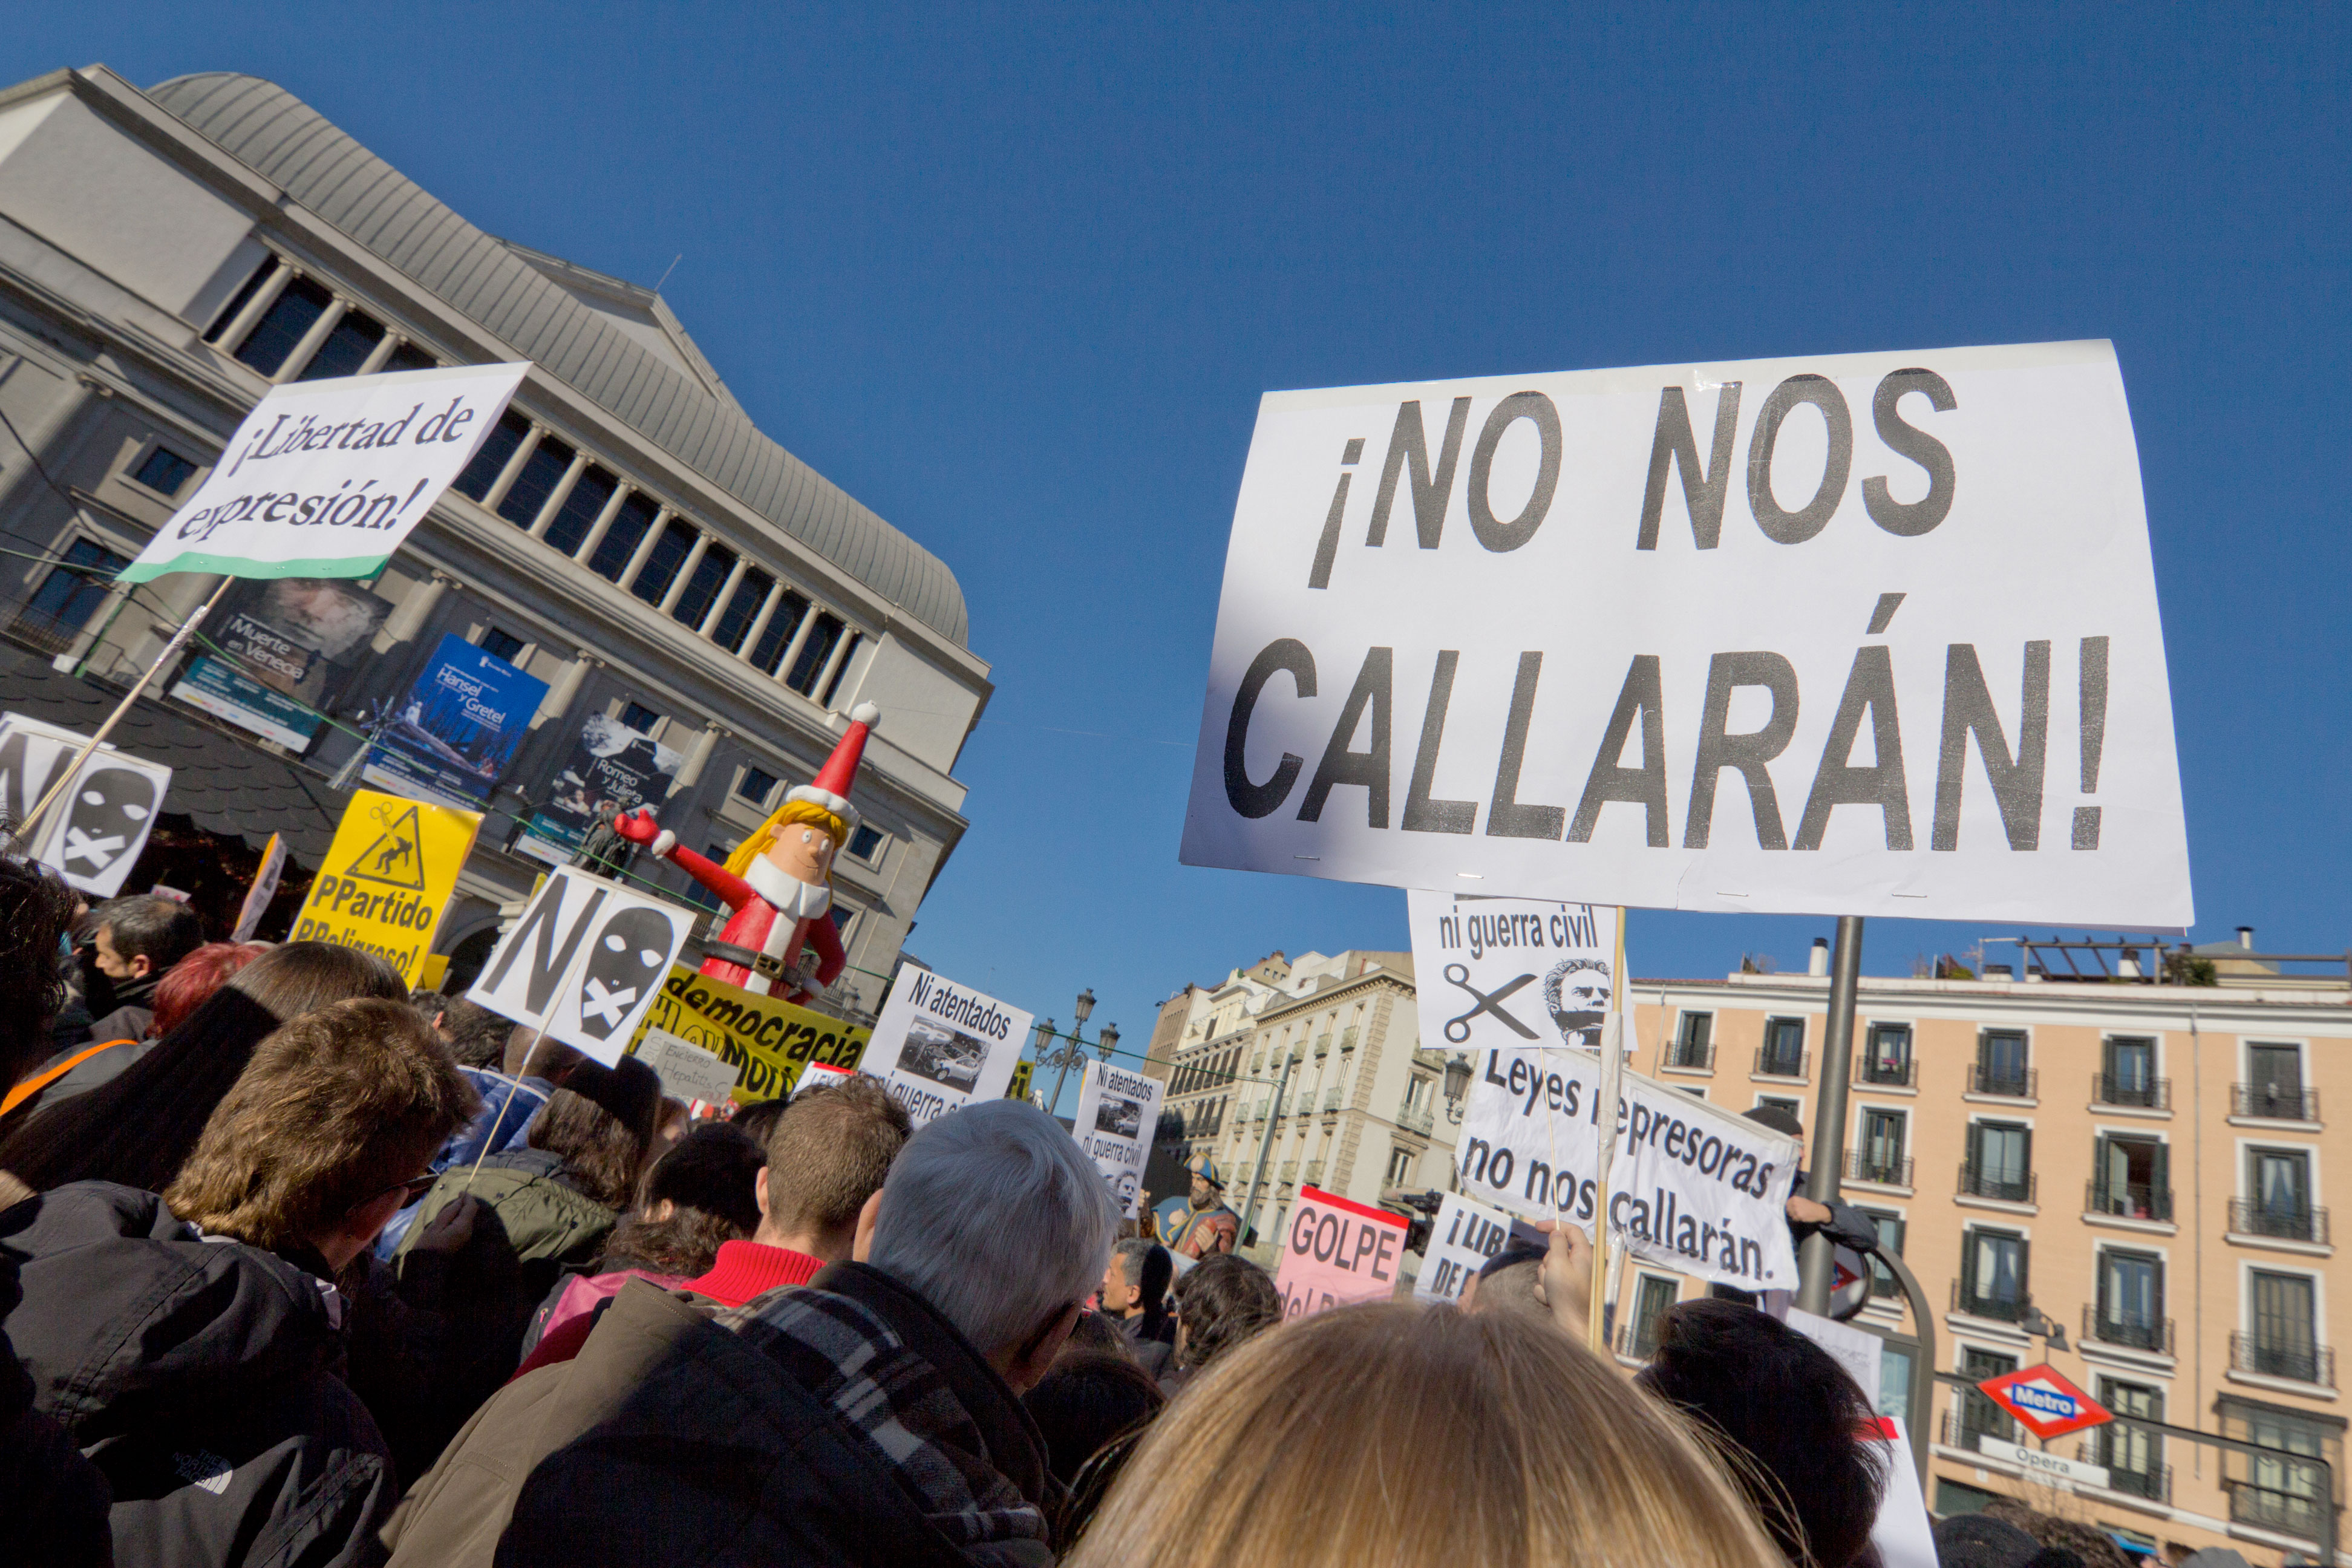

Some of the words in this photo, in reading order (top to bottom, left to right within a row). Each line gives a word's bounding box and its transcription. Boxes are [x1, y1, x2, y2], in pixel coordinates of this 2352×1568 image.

[227, 401, 425, 477] ¡Libertad
[414, 395, 475, 446] de
[1307, 388, 1563, 589] ¡NO
[1636, 367, 1958, 552] NOS
[176, 477, 430, 544] expresión!
[227, 639, 243, 651] en
[230, 618, 290, 656] Muerte
[436, 667, 483, 697] Hansel
[457, 693, 468, 702] y
[465, 697, 507, 724] Gretel
[1222, 592, 2111, 851] CALLARÁN!
[596, 759, 638, 787] Romeo
[601, 776, 610, 785] y
[607, 781, 644, 804] Julieta
[311, 874, 433, 932] PPartido
[1439, 904, 1462, 949] ni
[1468, 913, 1544, 961] guerra
[1549, 904, 1598, 948] civil
[666, 972, 864, 1071] democracia
[908, 972, 935, 1008] Ni
[929, 985, 1011, 1040] atentados
[1096, 1063, 1108, 1087] Ni
[1108, 1070, 1153, 1102] atentados
[1485, 1048, 1582, 1117] Leyes
[1083, 1131, 1094, 1154] ni
[1092, 1138, 1124, 1162] guerra
[1124, 1142, 1143, 1167] civil
[1462, 1136, 1514, 1190] no
[1524, 1158, 1596, 1221] nos
[1609, 1187, 1775, 1281] callarán.
[1292, 1206, 1397, 1283] GOLPE
[1431, 1256, 1463, 1298] DE
[2016, 1385, 2073, 1415] Metro
[2016, 1448, 2071, 1474] Opera
